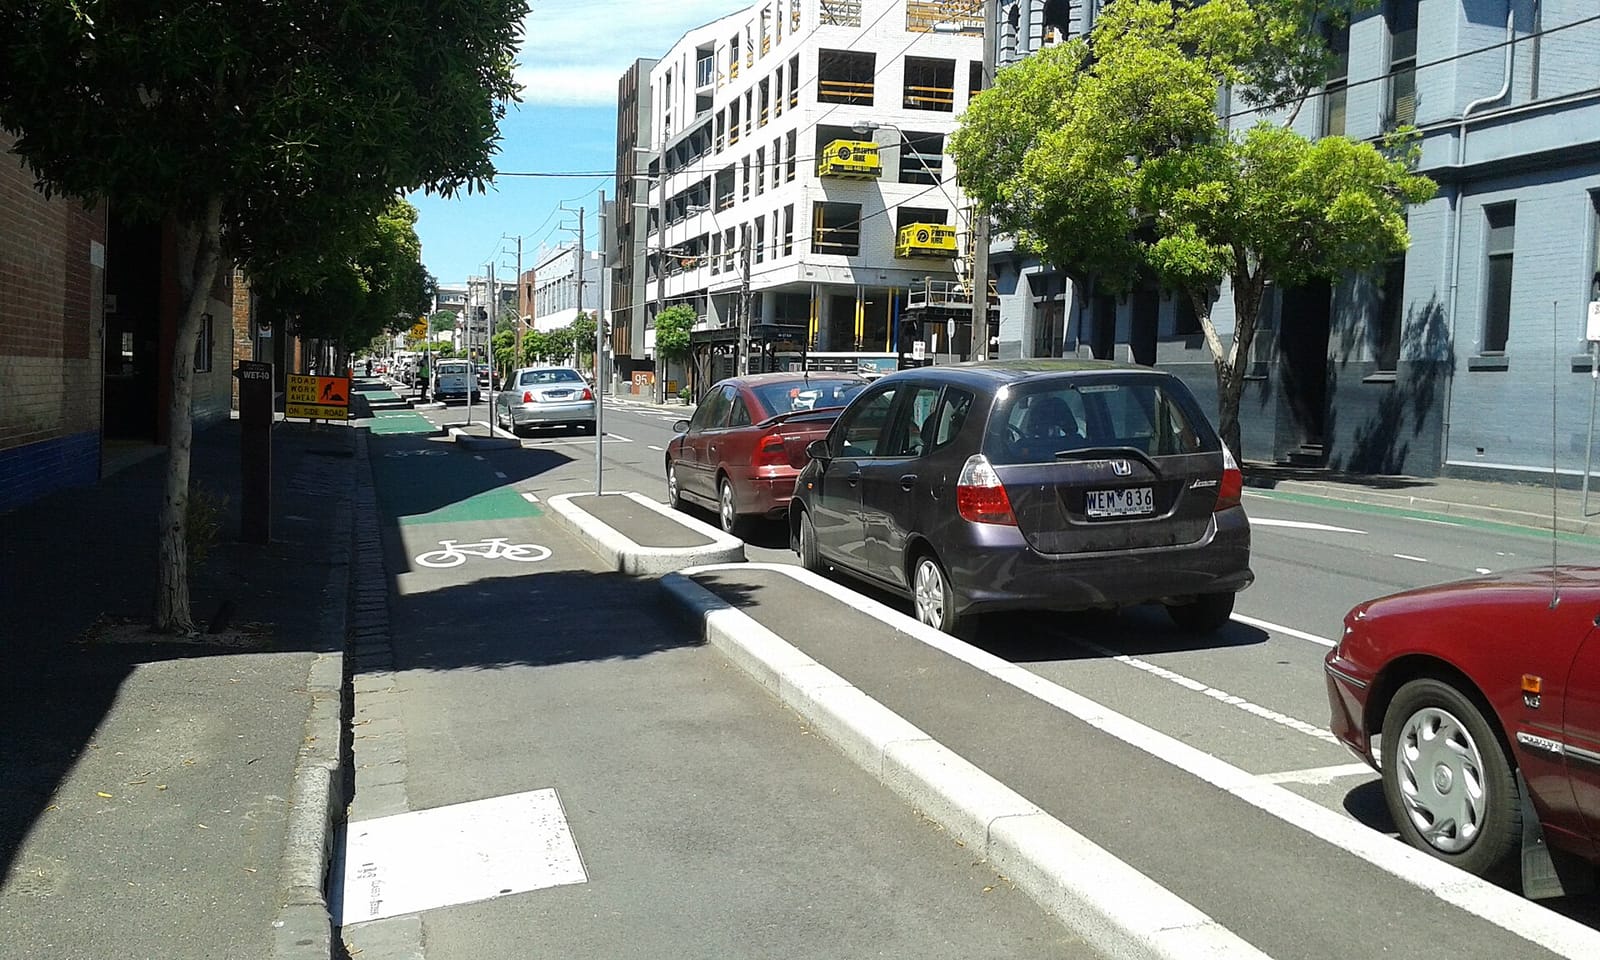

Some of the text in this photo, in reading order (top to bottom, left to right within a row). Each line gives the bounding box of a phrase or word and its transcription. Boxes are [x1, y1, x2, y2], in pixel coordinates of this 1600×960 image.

[291, 385, 316, 393] WORK
[289, 407, 344, 417] ON SIDE ROAD
[1087, 492, 1115, 509] WEM
[1126, 490, 1152, 506] 836
